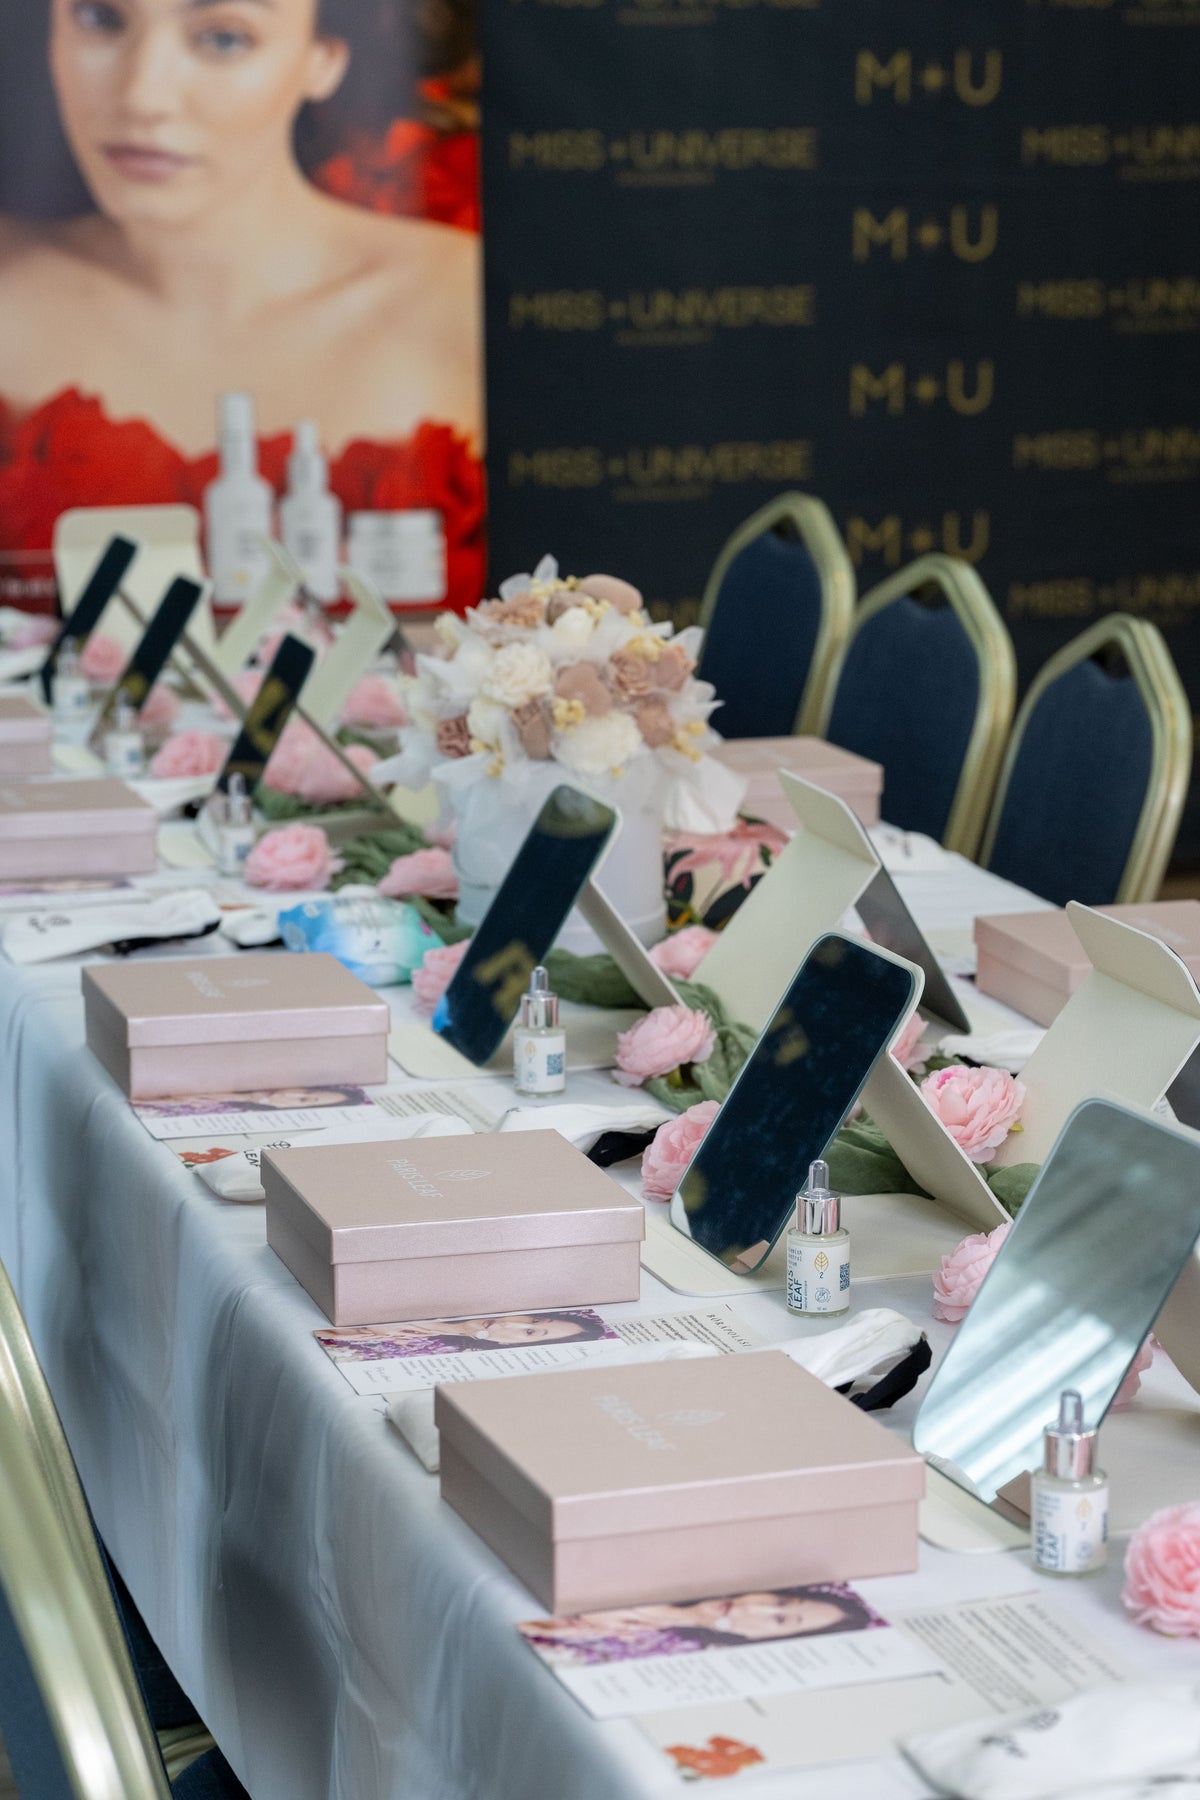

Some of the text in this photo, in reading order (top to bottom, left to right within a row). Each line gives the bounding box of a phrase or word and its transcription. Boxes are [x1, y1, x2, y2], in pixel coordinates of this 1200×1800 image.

[384, 1158, 444, 1200] PARIS LEAF
[794, 1278, 803, 1310] LEAF
